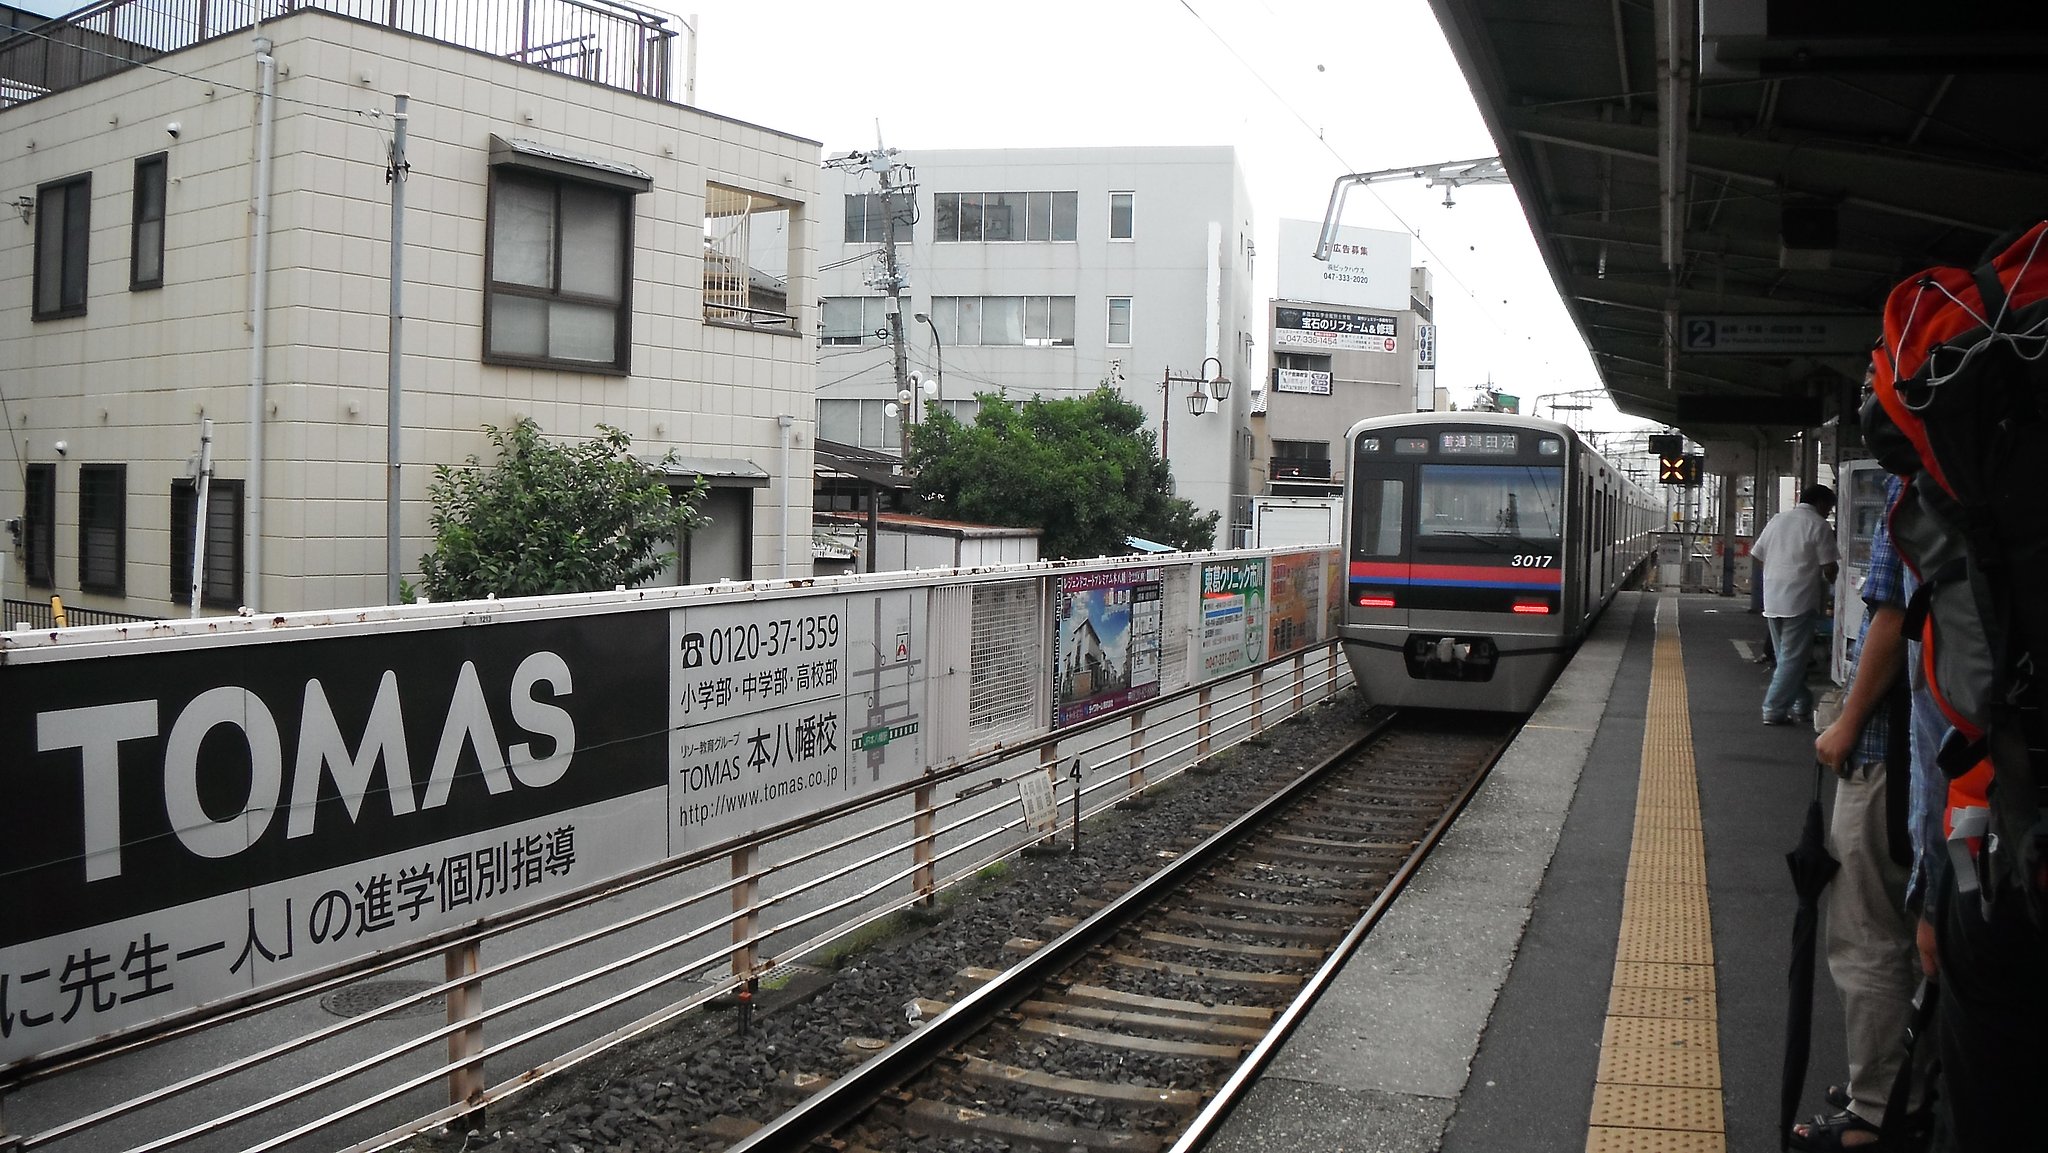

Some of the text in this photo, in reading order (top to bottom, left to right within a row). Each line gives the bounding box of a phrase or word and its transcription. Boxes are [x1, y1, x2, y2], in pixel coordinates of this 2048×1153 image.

[1323, 273, 1369, 284] 047-333-2020
[1692, 320, 1712, 347] 2
[1443, 434, 1516, 449] 普通 津田沼
[1511, 554, 1553, 568] 3017
[1204, 562, 1264, 594] 東葛クリニック市川
[709, 613, 839, 666] 0120-37-1359
[680, 658, 838, 714] 小学部・中学部・高校部
[680, 731, 741, 759] リソー教育グループ
[680, 755, 741, 794] TOMAS
[747, 711, 838, 773] 本八幡校
[36, 650, 577, 883] TOMAS
[1069, 758, 1083, 784] 4
[679, 763, 839, 827] http://www.tomas.co.jp
